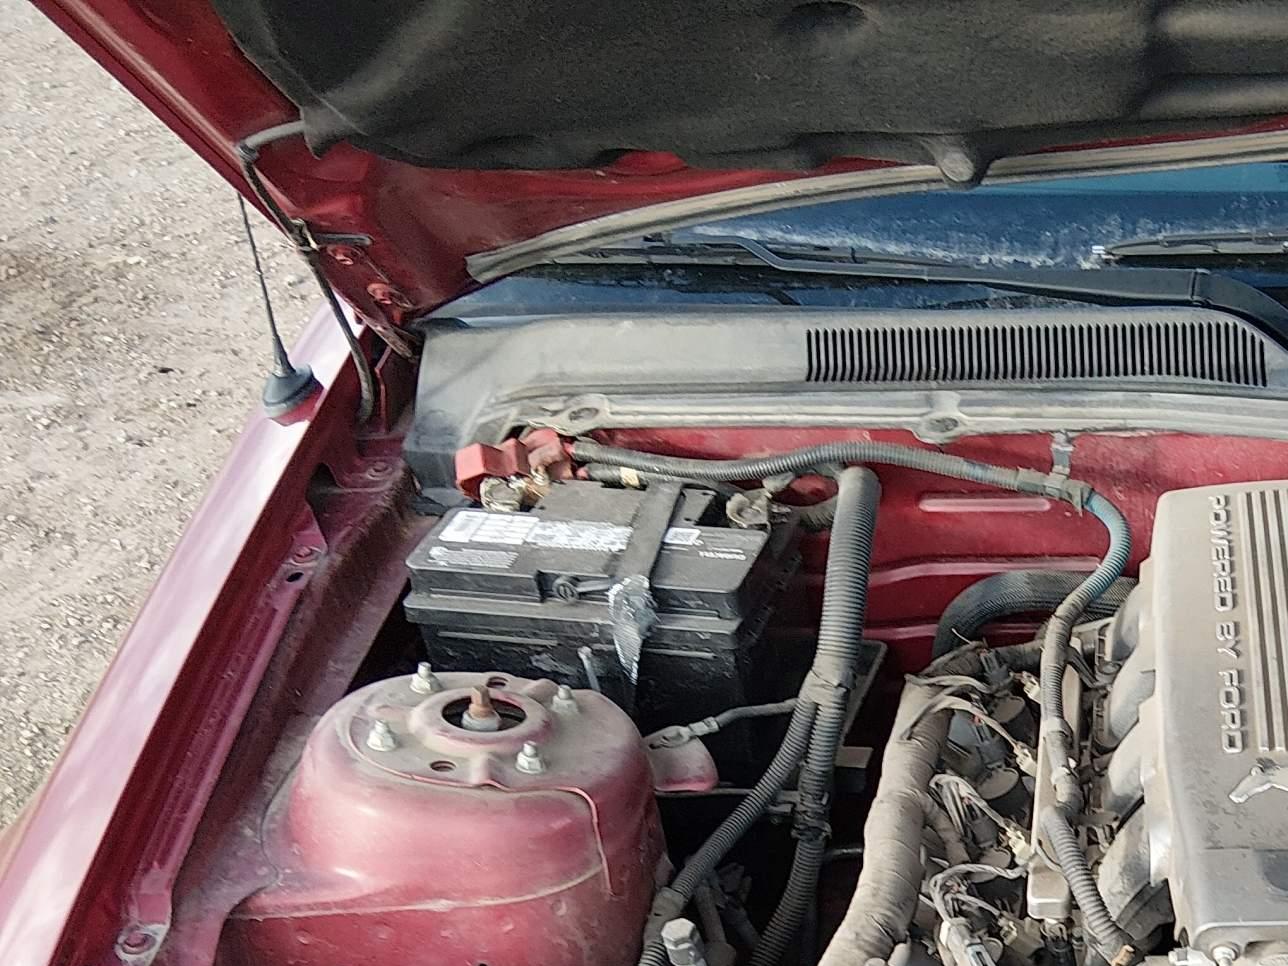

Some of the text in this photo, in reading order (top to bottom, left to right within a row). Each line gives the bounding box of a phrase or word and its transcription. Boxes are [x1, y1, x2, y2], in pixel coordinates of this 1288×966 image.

[1208, 495, 1244, 754] POWERED BY FORD
